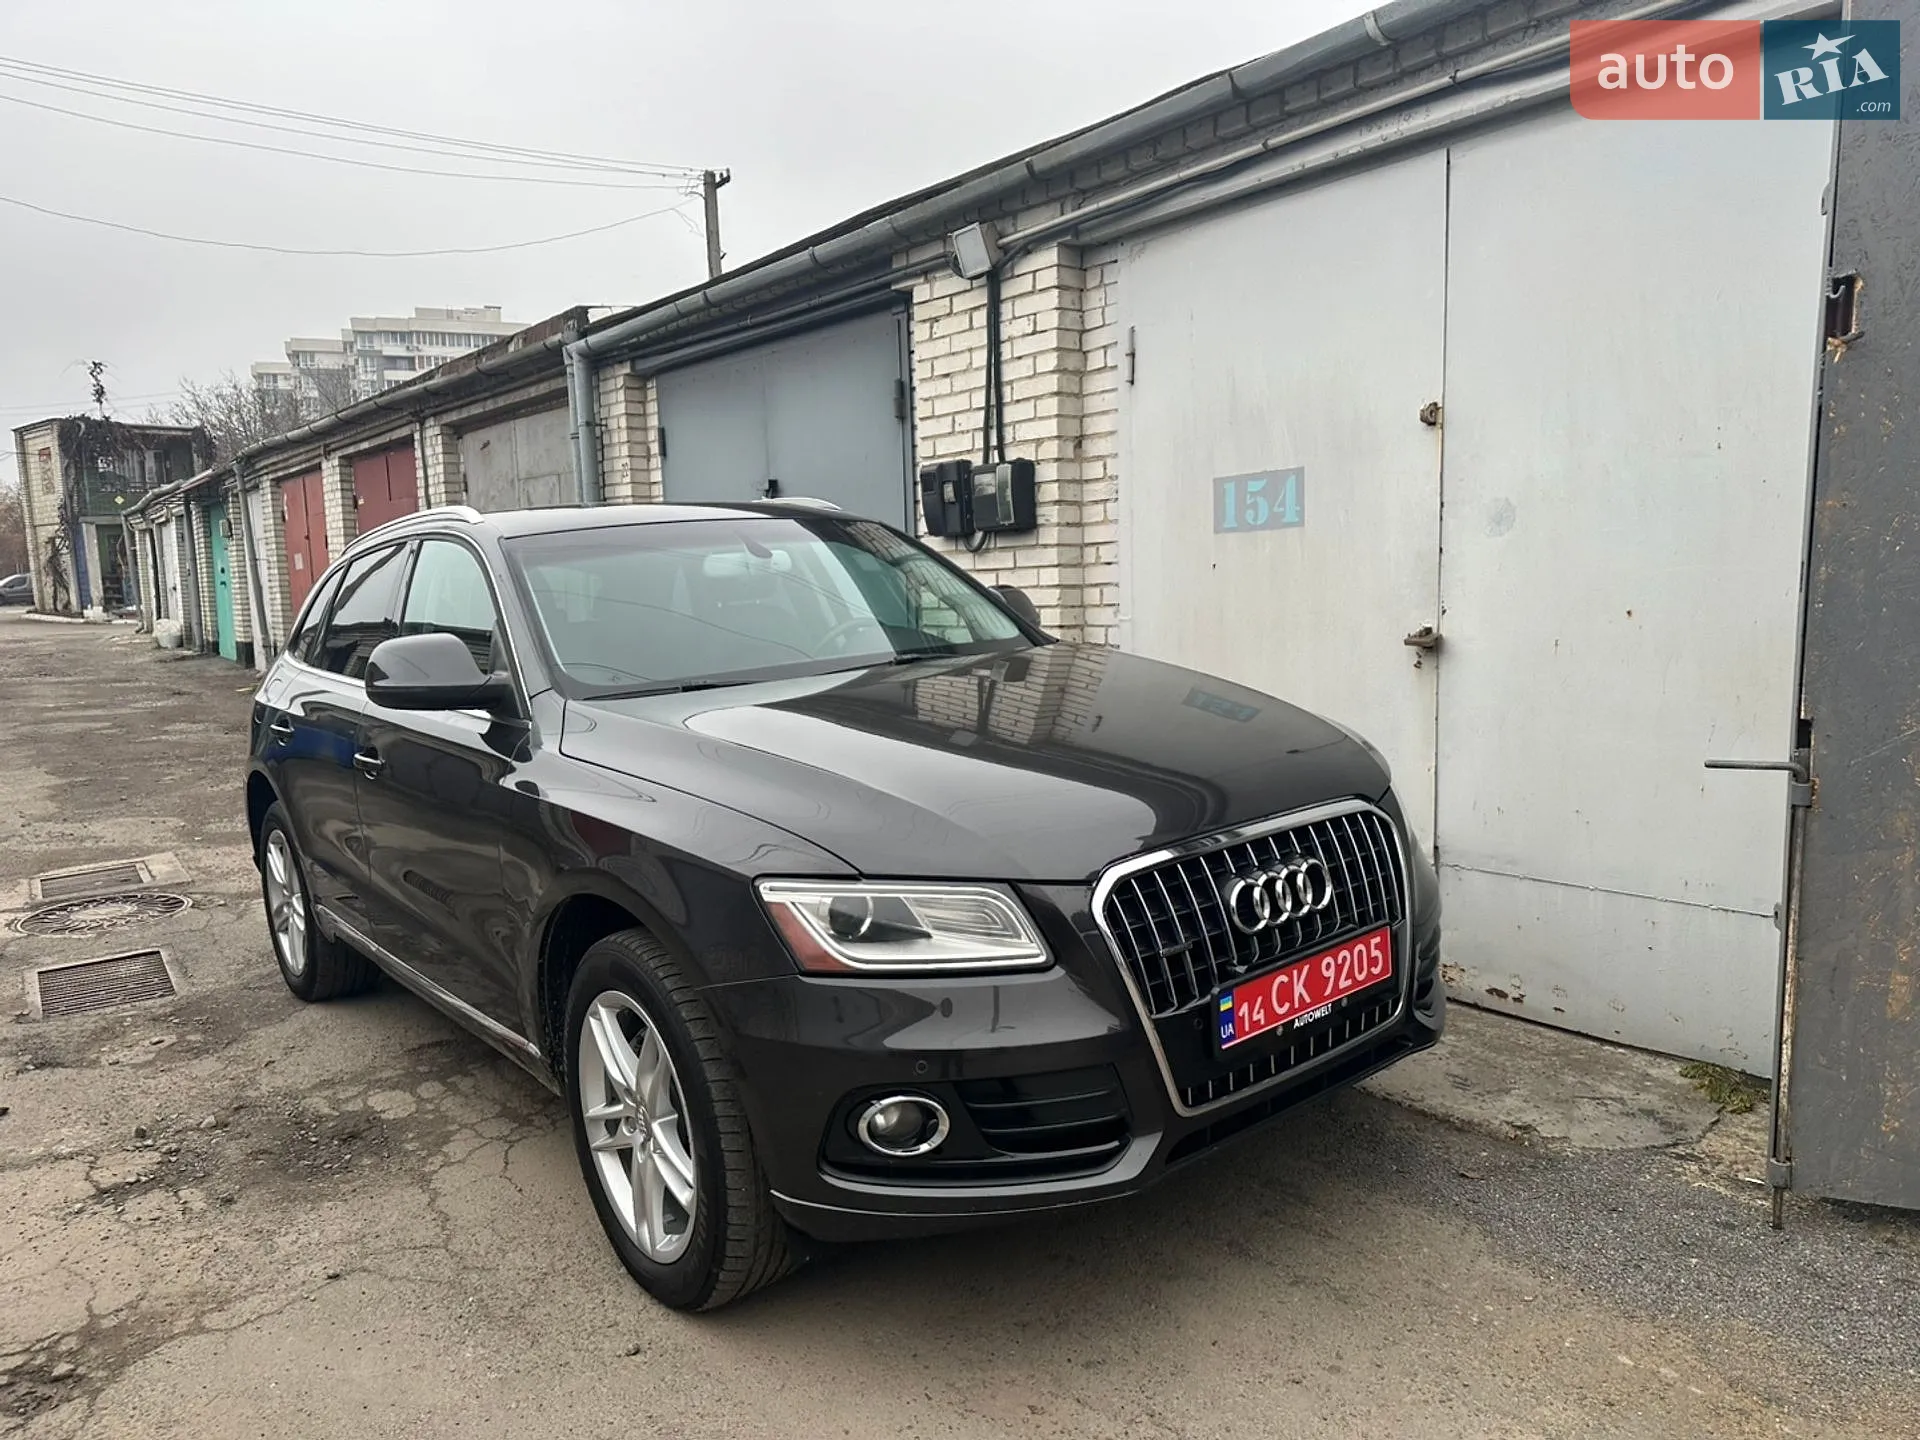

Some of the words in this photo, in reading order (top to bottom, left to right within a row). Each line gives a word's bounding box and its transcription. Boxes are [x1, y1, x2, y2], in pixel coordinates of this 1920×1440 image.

[1223, 475, 1301, 528] 154
[1238, 995, 1266, 1033] 14
[1271, 964, 1311, 1015] CK
[1321, 936, 1384, 996] 9205
[1220, 1023, 1235, 1039] UA
[1293, 1003, 1332, 1029] AUTOWELT
